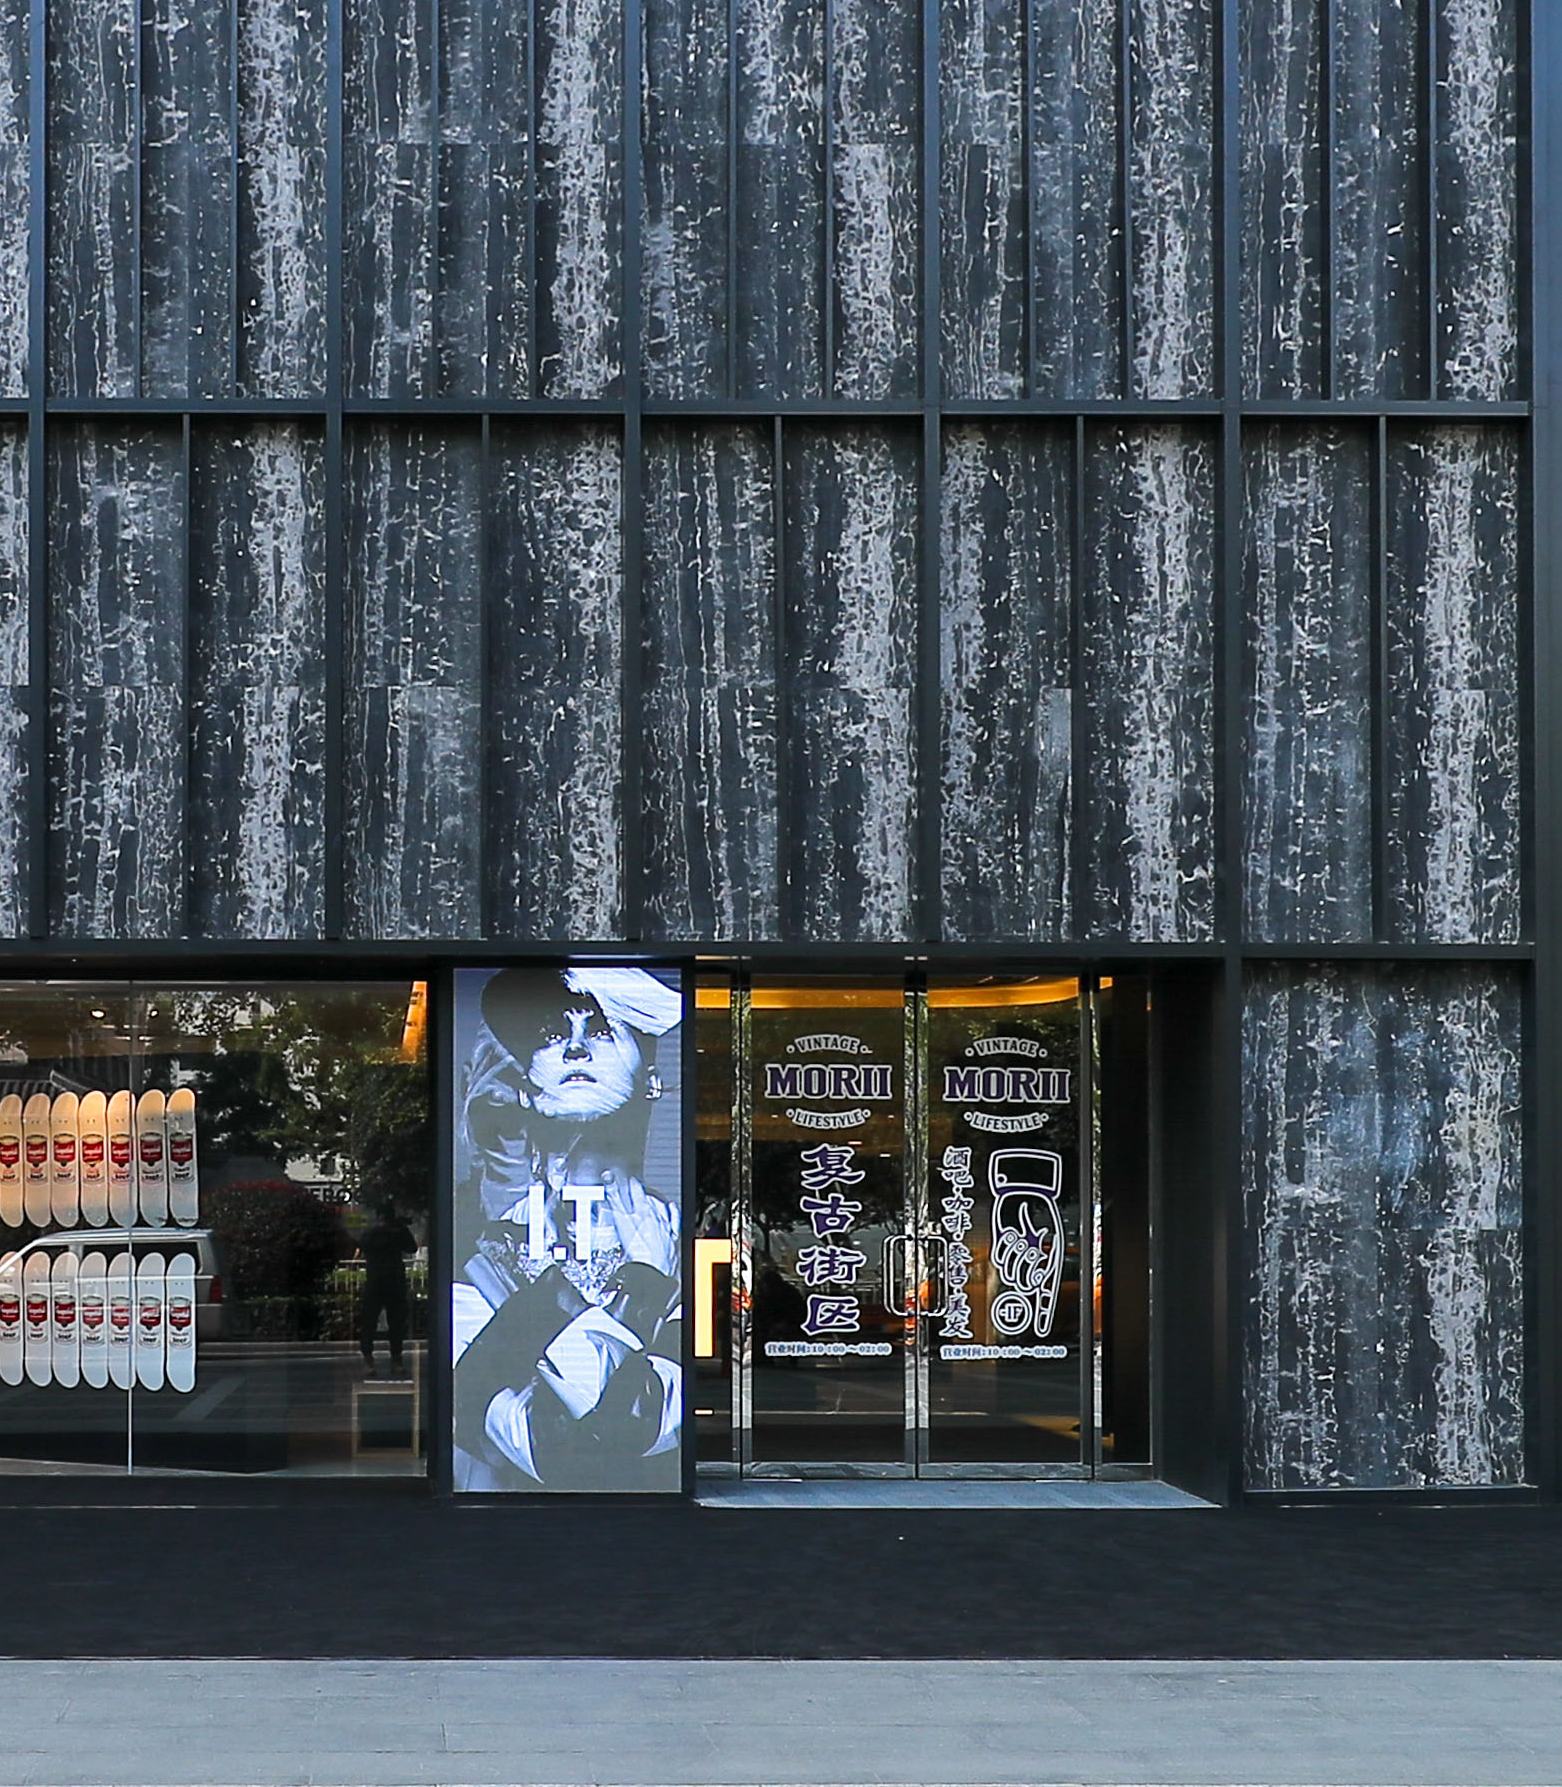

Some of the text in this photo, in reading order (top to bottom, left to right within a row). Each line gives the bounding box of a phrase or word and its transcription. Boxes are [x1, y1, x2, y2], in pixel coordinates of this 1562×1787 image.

[794, 1034, 860, 1053] VINTAGE
[974, 1037, 1039, 1057] VINTAGE
[765, 1063, 892, 1099] MORII
[942, 1066, 1070, 1103] MORII
[792, 1107, 863, 1129] LIFESTYLE
[970, 1112, 1043, 1133] LIFESTYLE
[529, 1185, 605, 1260] I.T
[796, 1143, 867, 1335] 复古街区
